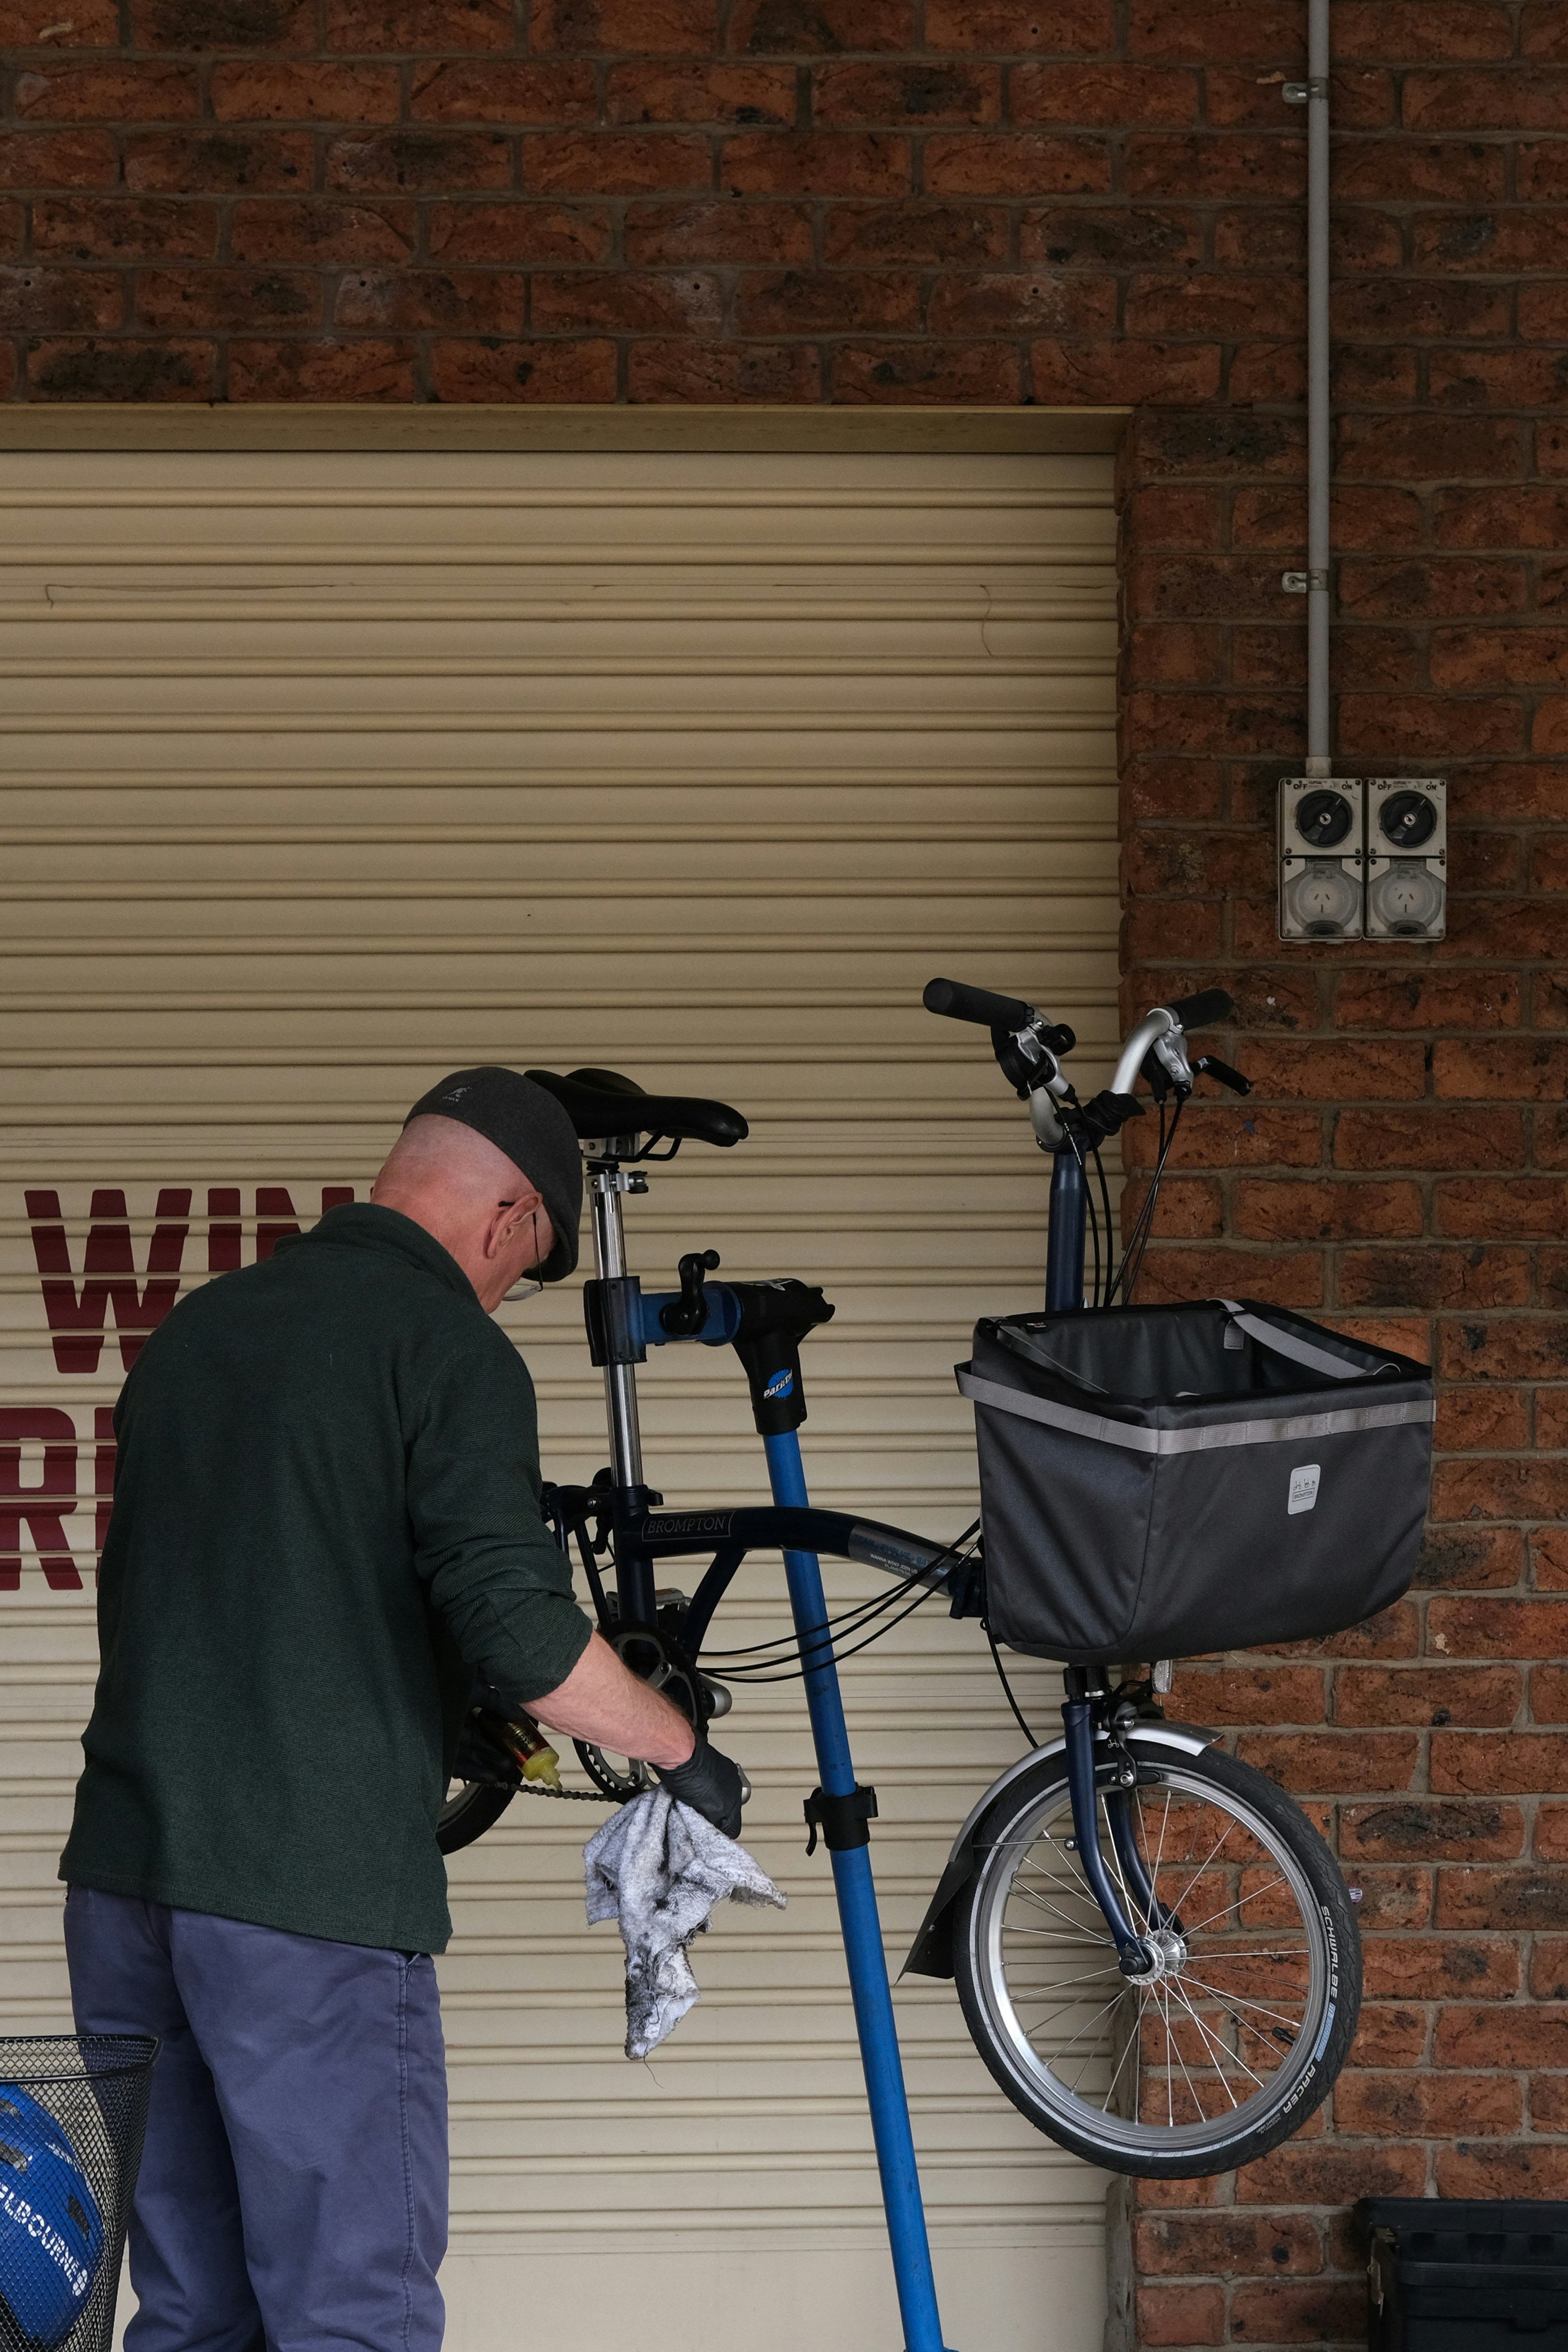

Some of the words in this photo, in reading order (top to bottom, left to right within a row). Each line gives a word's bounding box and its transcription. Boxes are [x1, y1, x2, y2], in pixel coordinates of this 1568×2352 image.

[647, 1516, 726, 1534] BROMPTON
[1321, 1905, 1339, 1998] SCHWALBE
[1283, 2063, 1316, 2114] RACER
